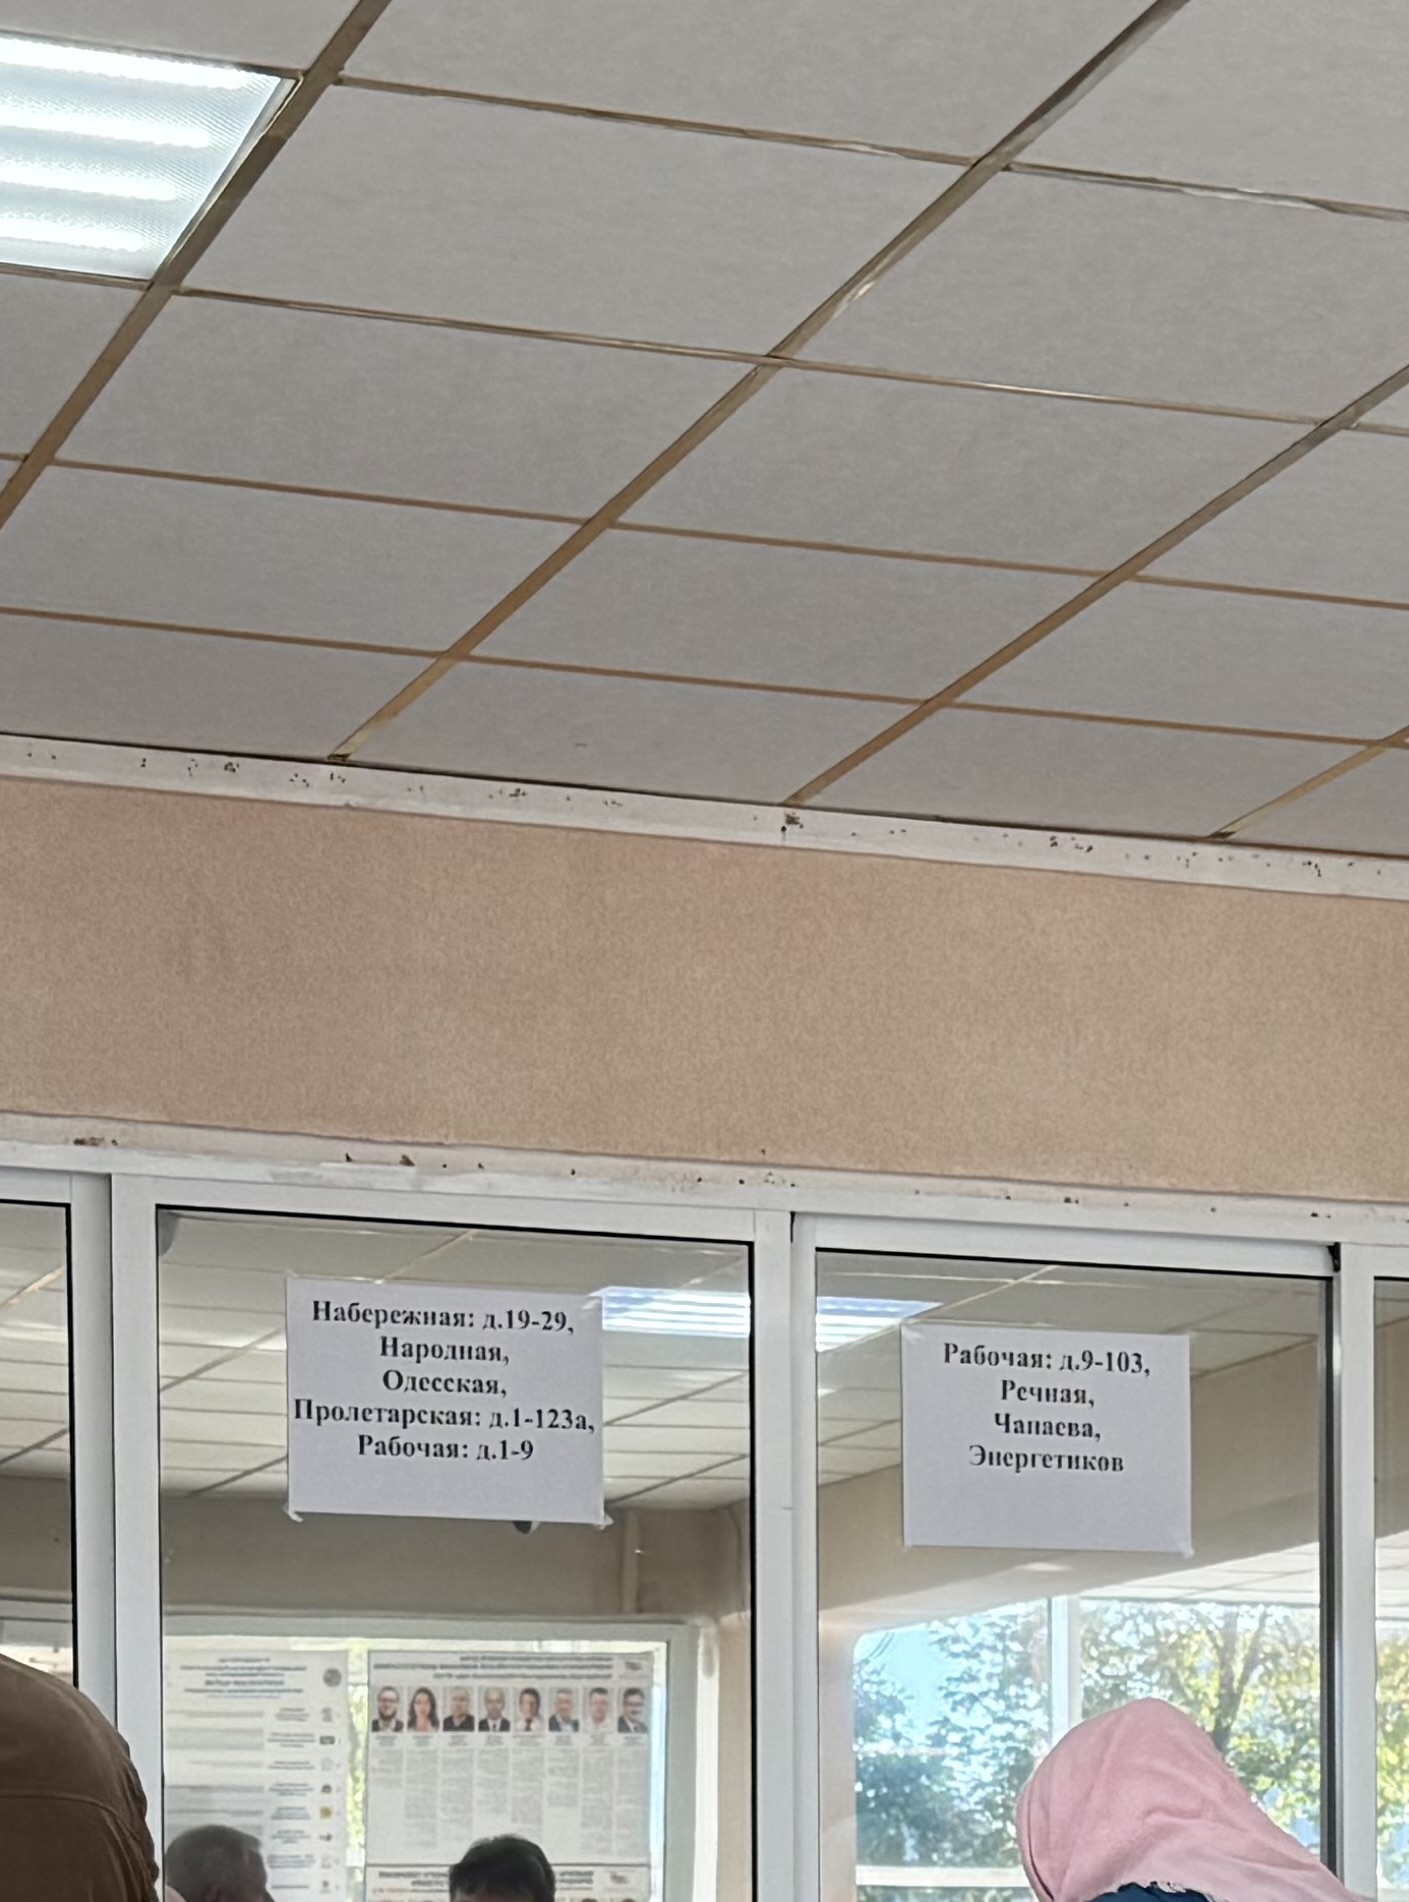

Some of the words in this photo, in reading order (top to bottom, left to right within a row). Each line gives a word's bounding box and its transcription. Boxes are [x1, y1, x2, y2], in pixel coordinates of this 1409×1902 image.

[313, 1300, 474, 1330] Набережная:
[482, 1309, 574, 1334] д.19-29,
[380, 1335, 510, 1365] Народная,
[944, 1342, 1052, 1370] Рабочая:
[1059, 1350, 1150, 1377] д.9-103,
[382, 1369, 507, 1397] Одесская,
[1001, 1379, 1095, 1408] Речная,
[294, 1398, 481, 1430] Пролетарская:
[489, 1407, 595, 1434] д.1-123а,
[994, 1412, 1101, 1441] Чапаева,
[358, 1434, 468, 1459] Рабочая:
[476, 1439, 534, 1461] д.1-9
[969, 1444, 1124, 1474] Энергетиков
